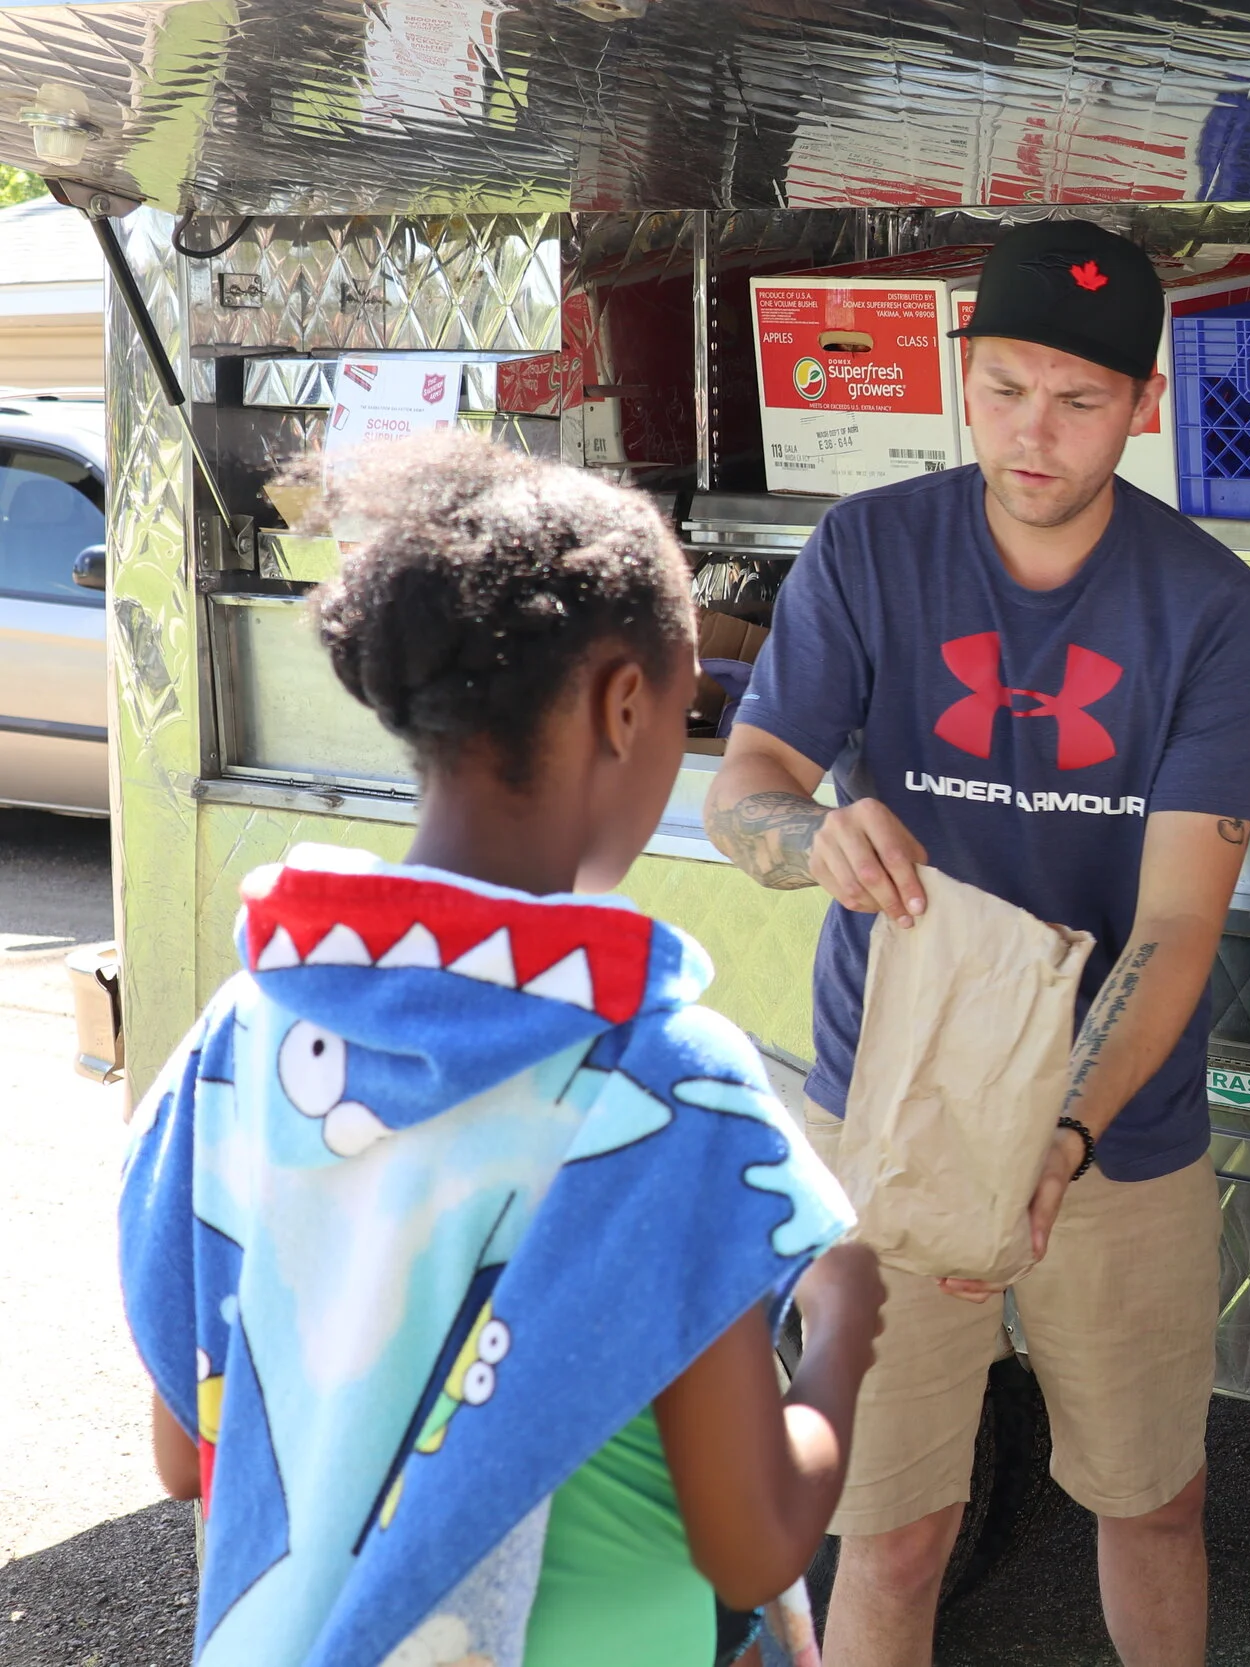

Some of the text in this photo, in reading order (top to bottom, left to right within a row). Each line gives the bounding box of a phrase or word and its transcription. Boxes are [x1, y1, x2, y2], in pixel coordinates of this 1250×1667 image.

[759, 291, 785, 299] PRODUCE
[876, 310, 901, 318] YAKIMA,
[763, 332, 937, 347] APPLES CLASS 1
[828, 362, 903, 383] superfresh
[848, 383, 904, 400] growers
[366, 418, 411, 432] SCHOOL
[771, 443, 783, 458] 113
[905, 770, 1146, 817] UNDER ARMOUR
